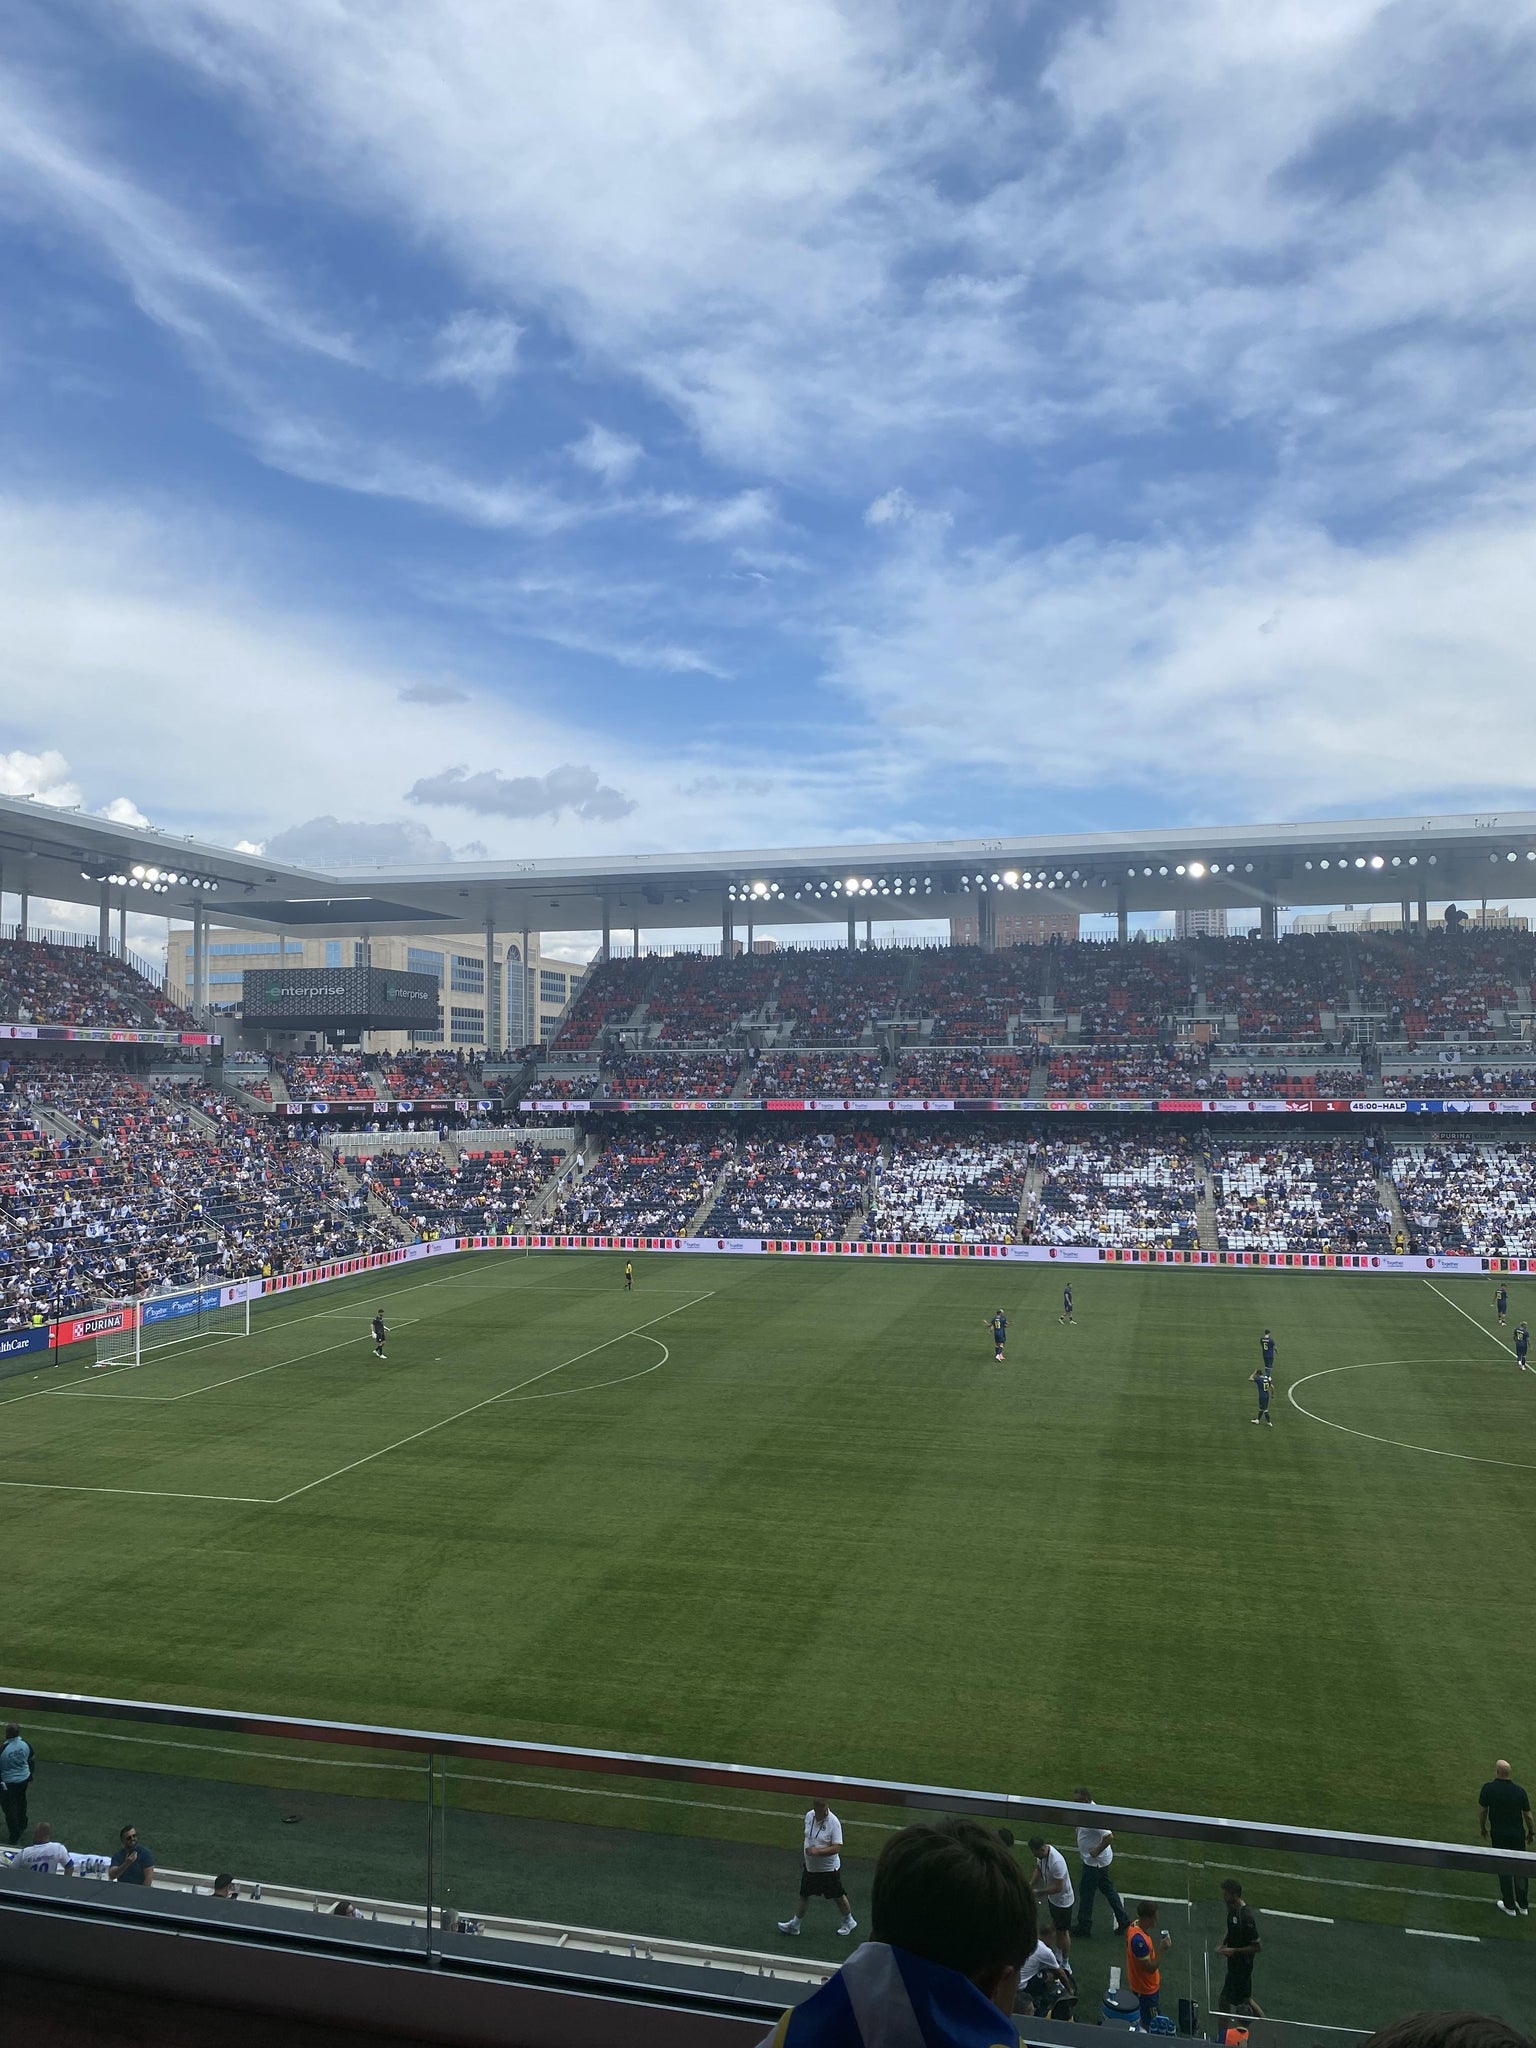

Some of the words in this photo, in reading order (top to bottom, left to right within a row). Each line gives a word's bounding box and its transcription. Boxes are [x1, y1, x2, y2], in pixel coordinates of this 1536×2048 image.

[266, 984, 345, 998] enterprise
[387, 984, 429, 1000] enterprise
[1352, 1102, 1406, 1110] 45:00-HALF
[1420, 1102, 1429, 1111] 1
[85, 1316, 121, 1333] PURINA
[0, 1339, 30, 1353] lthCare
